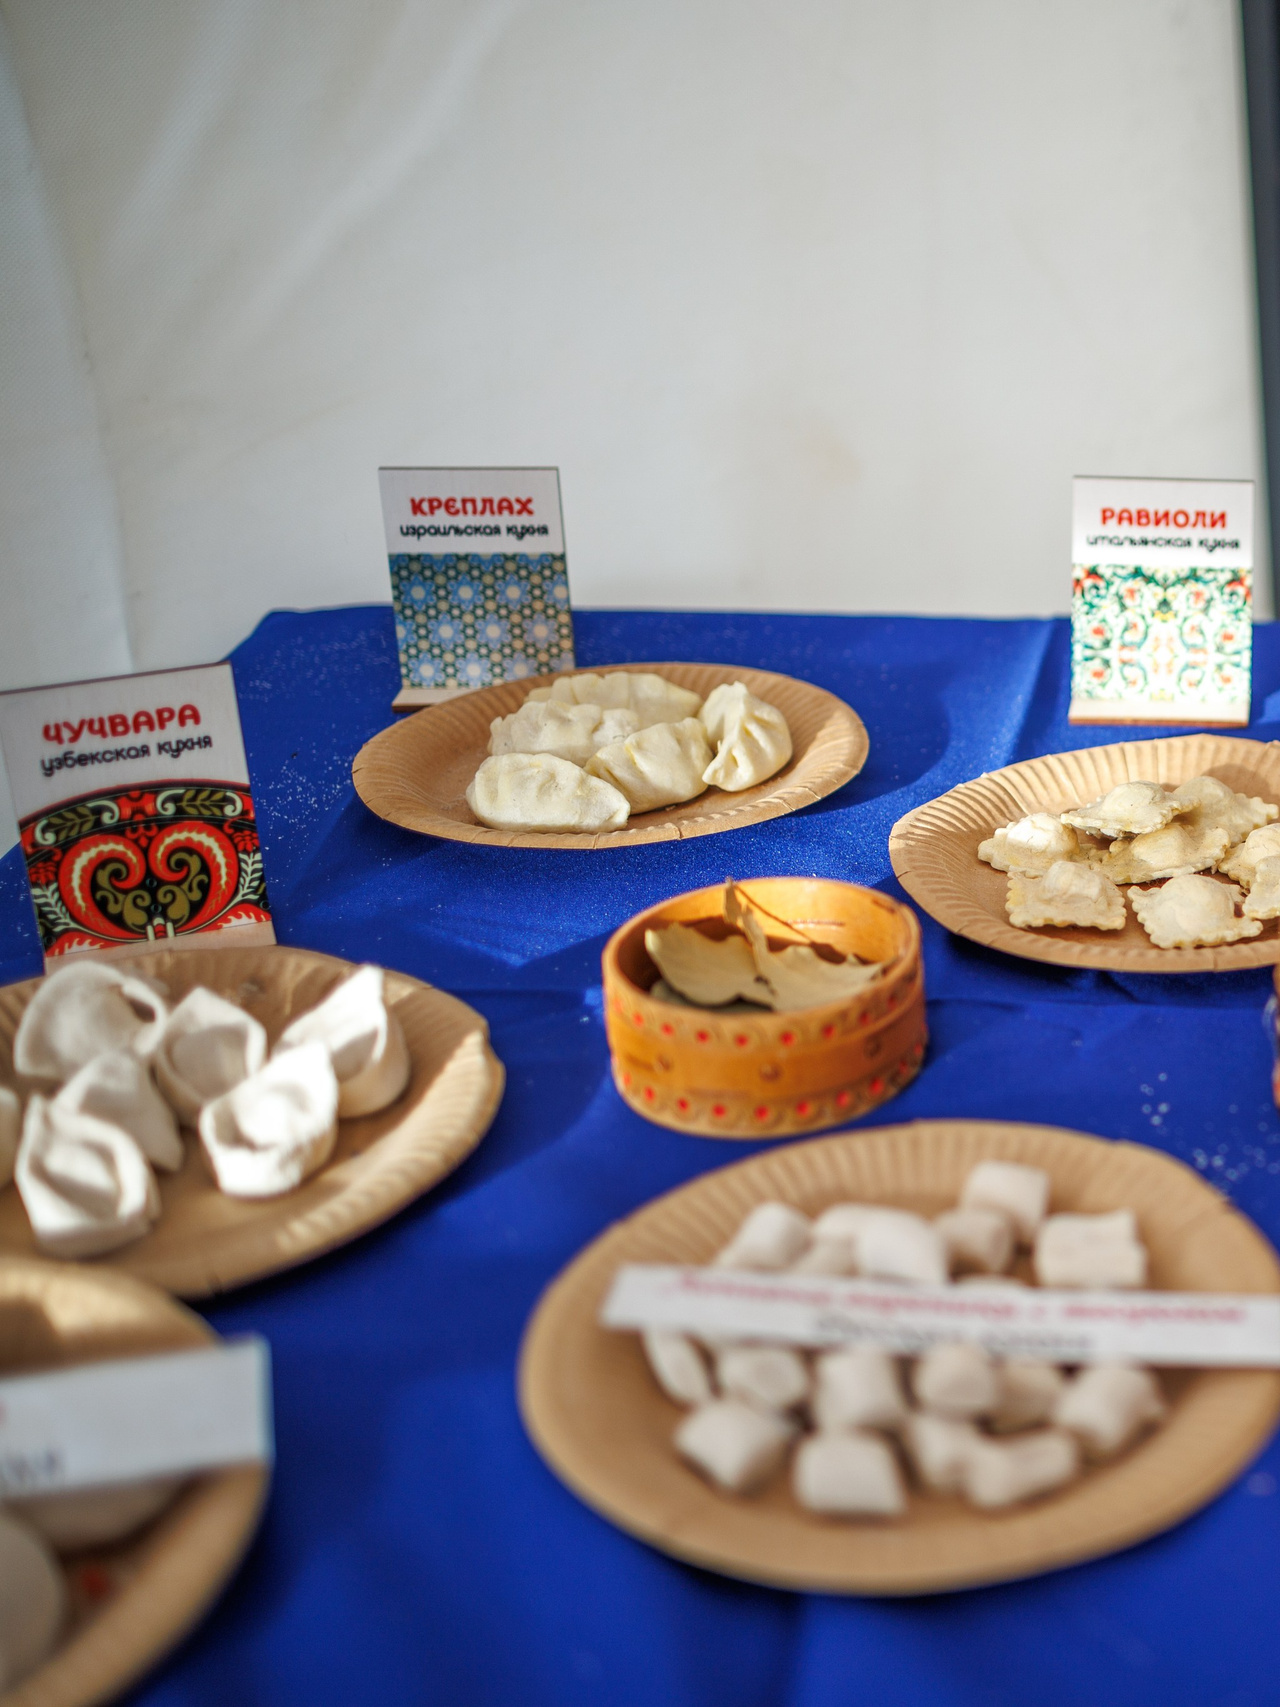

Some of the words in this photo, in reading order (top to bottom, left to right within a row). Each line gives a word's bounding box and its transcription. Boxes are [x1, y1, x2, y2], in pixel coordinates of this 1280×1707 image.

[410, 497, 535, 517] КРЕПЛАХ
[1101, 507, 1227, 529] РАВИОЛИ
[400, 524, 501, 541] израильская
[506, 524, 549, 541] кухня
[1087, 534, 1193, 549] итальянская
[1198, 537, 1240, 553] кухня
[42, 703, 202, 745] ЧУЧВАРА
[40, 742, 151, 777] узбекская
[157, 735, 213, 759] кухня
